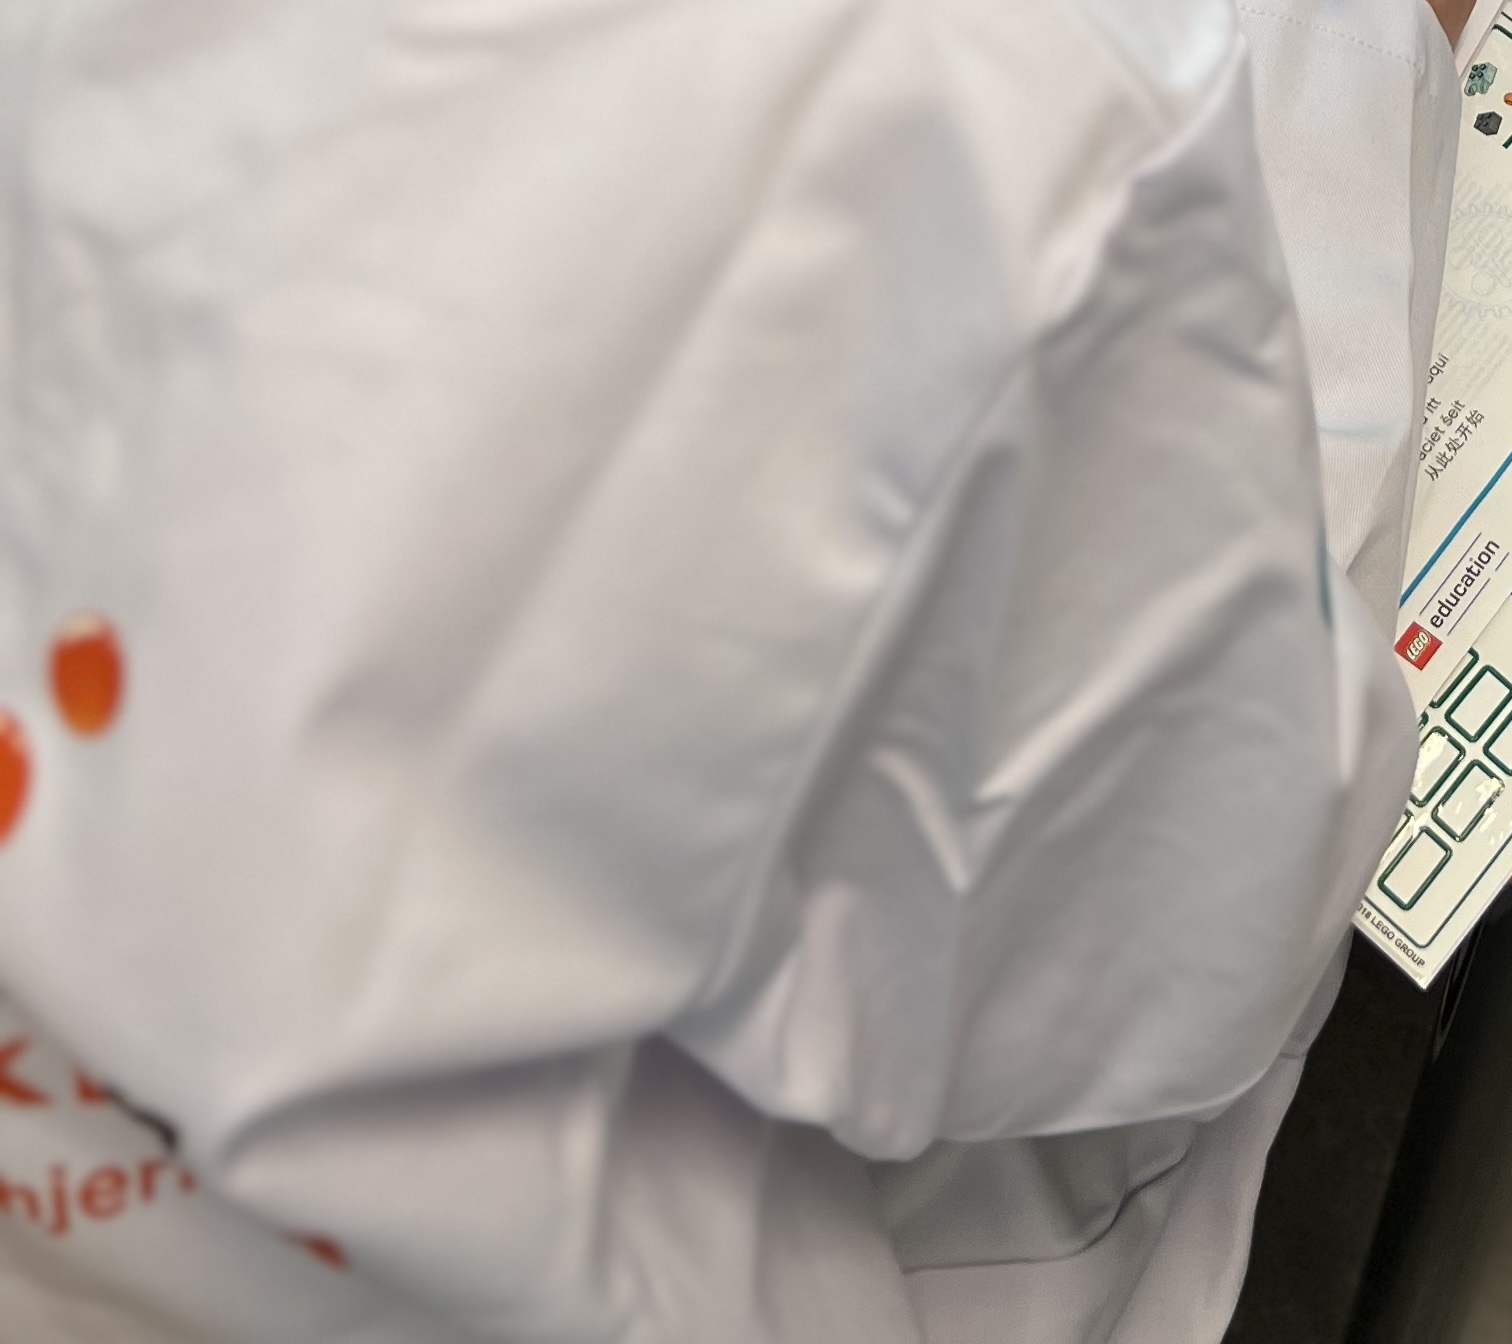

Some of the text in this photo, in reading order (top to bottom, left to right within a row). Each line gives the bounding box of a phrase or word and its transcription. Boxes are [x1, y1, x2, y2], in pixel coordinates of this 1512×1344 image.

[1424, 409, 1485, 482] 从此处开始
[1439, 399, 1466, 427] šeit
[1429, 540, 1500, 628] education
[1357, 902, 1426, 967] 018 LEGO GROUP
